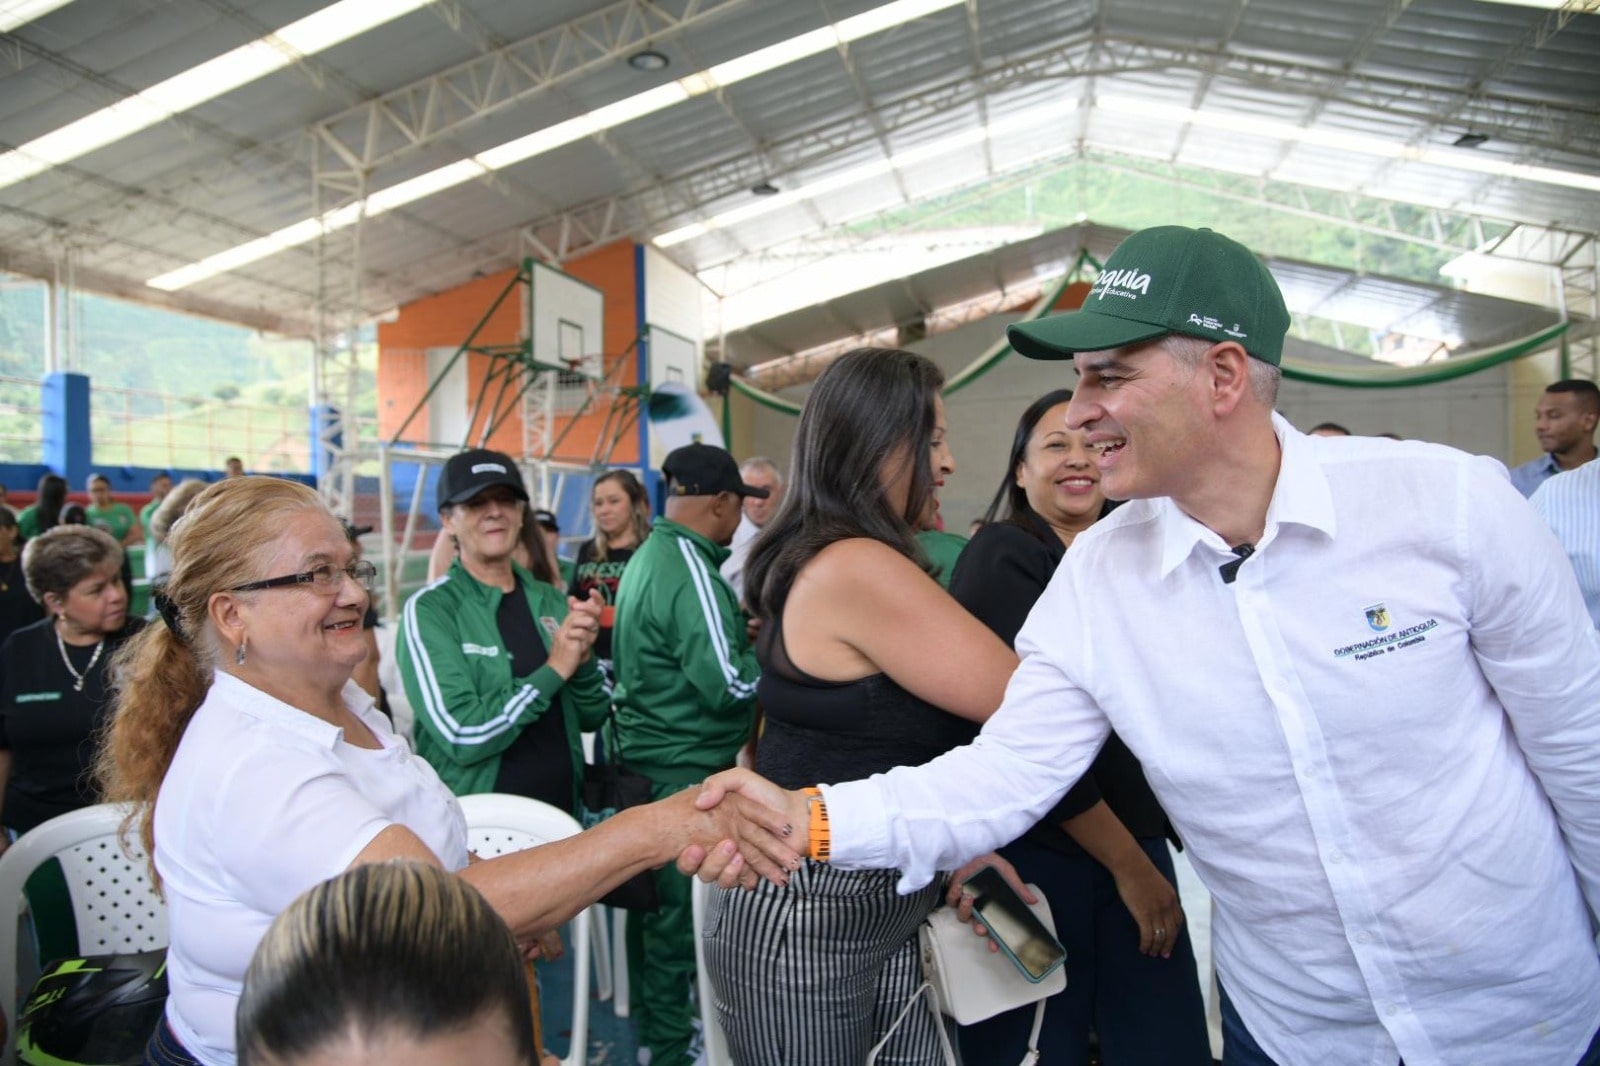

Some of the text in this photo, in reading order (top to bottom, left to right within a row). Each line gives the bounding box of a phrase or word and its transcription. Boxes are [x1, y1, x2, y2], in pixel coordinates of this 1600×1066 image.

[1334, 619, 1437, 656] GOBERNACIÓN DE ANTIOQUIA
[1397, 636, 1426, 649] Colombia
